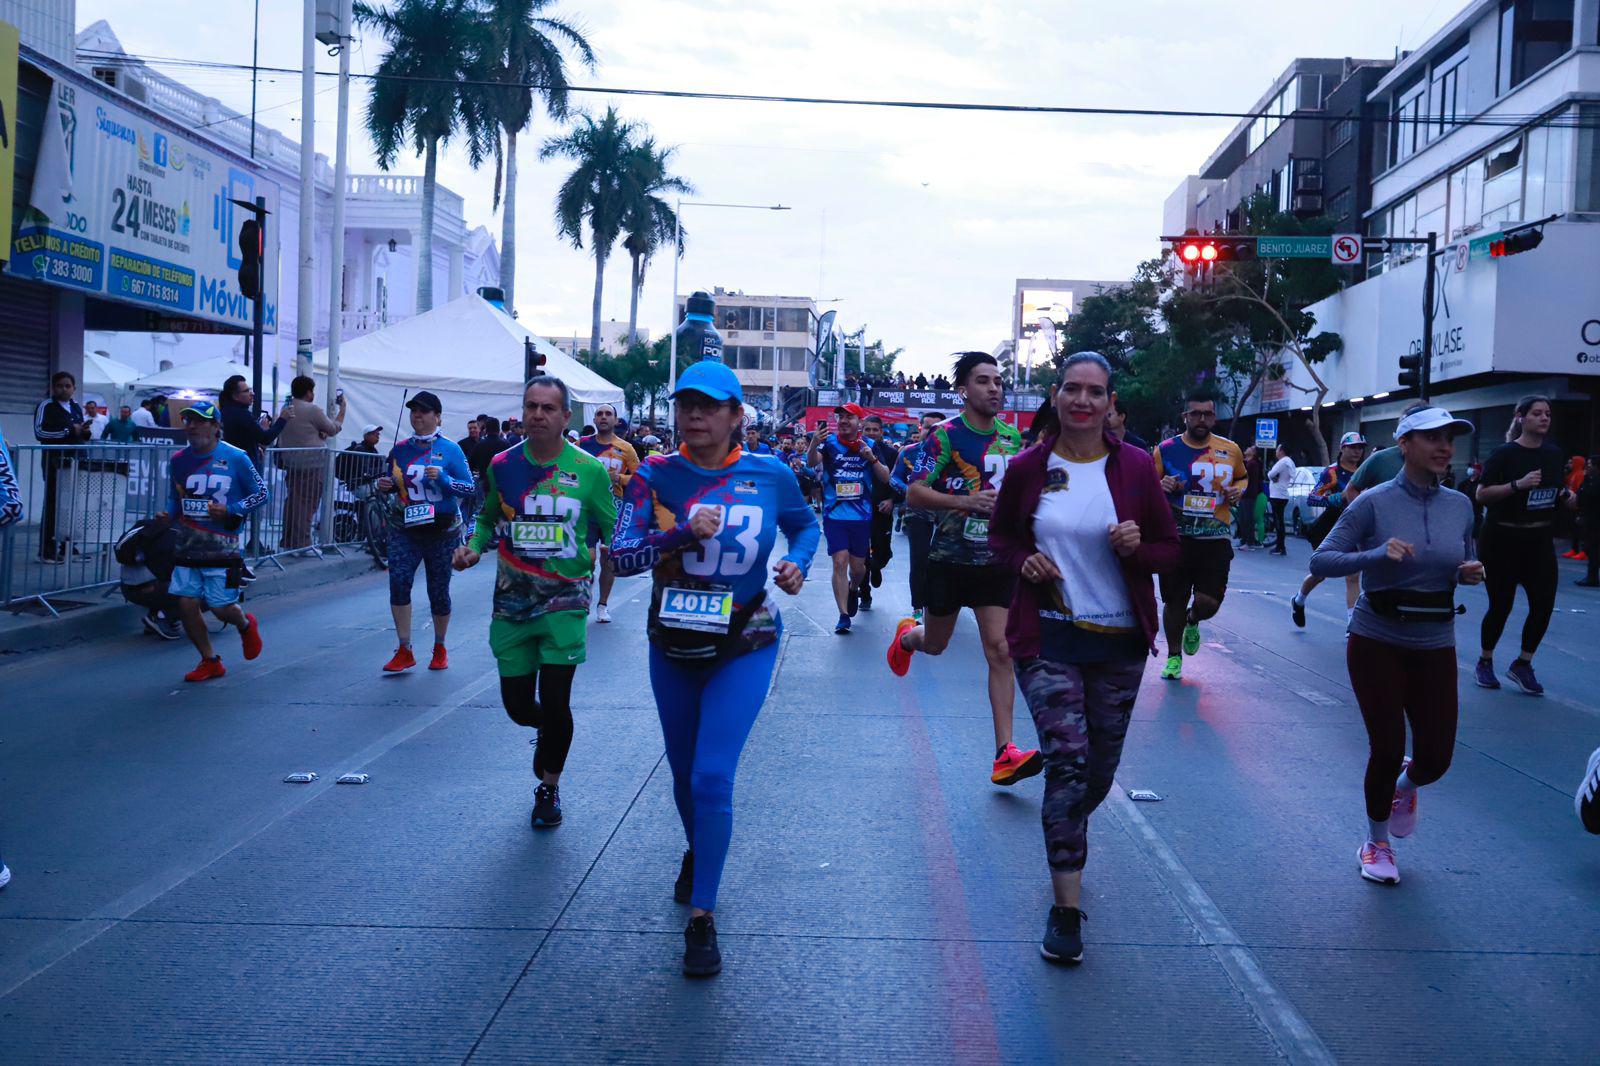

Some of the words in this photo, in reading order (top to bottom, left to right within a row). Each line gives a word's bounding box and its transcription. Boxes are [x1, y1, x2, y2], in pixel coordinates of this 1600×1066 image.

[127, 174, 152, 197] HASTA
[111, 188, 140, 238] 24
[143, 199, 176, 235] MESES
[1260, 243, 1292, 254] BENITO
[1293, 243, 1328, 254] JUAREZ
[52, 259, 70, 278] 383
[71, 263, 93, 283] 3000
[132, 279, 146, 296] 667
[147, 283, 161, 298] 715
[162, 286, 179, 303] 8314
[703, 346, 721, 358] PO
[878, 391, 905, 399] POWER
[910, 391, 936, 399] POWER
[185, 501, 208, 512] 3993
[407, 506, 430, 518] 3527
[517, 525, 555, 541] 2201
[670, 593, 722, 613] 4015
